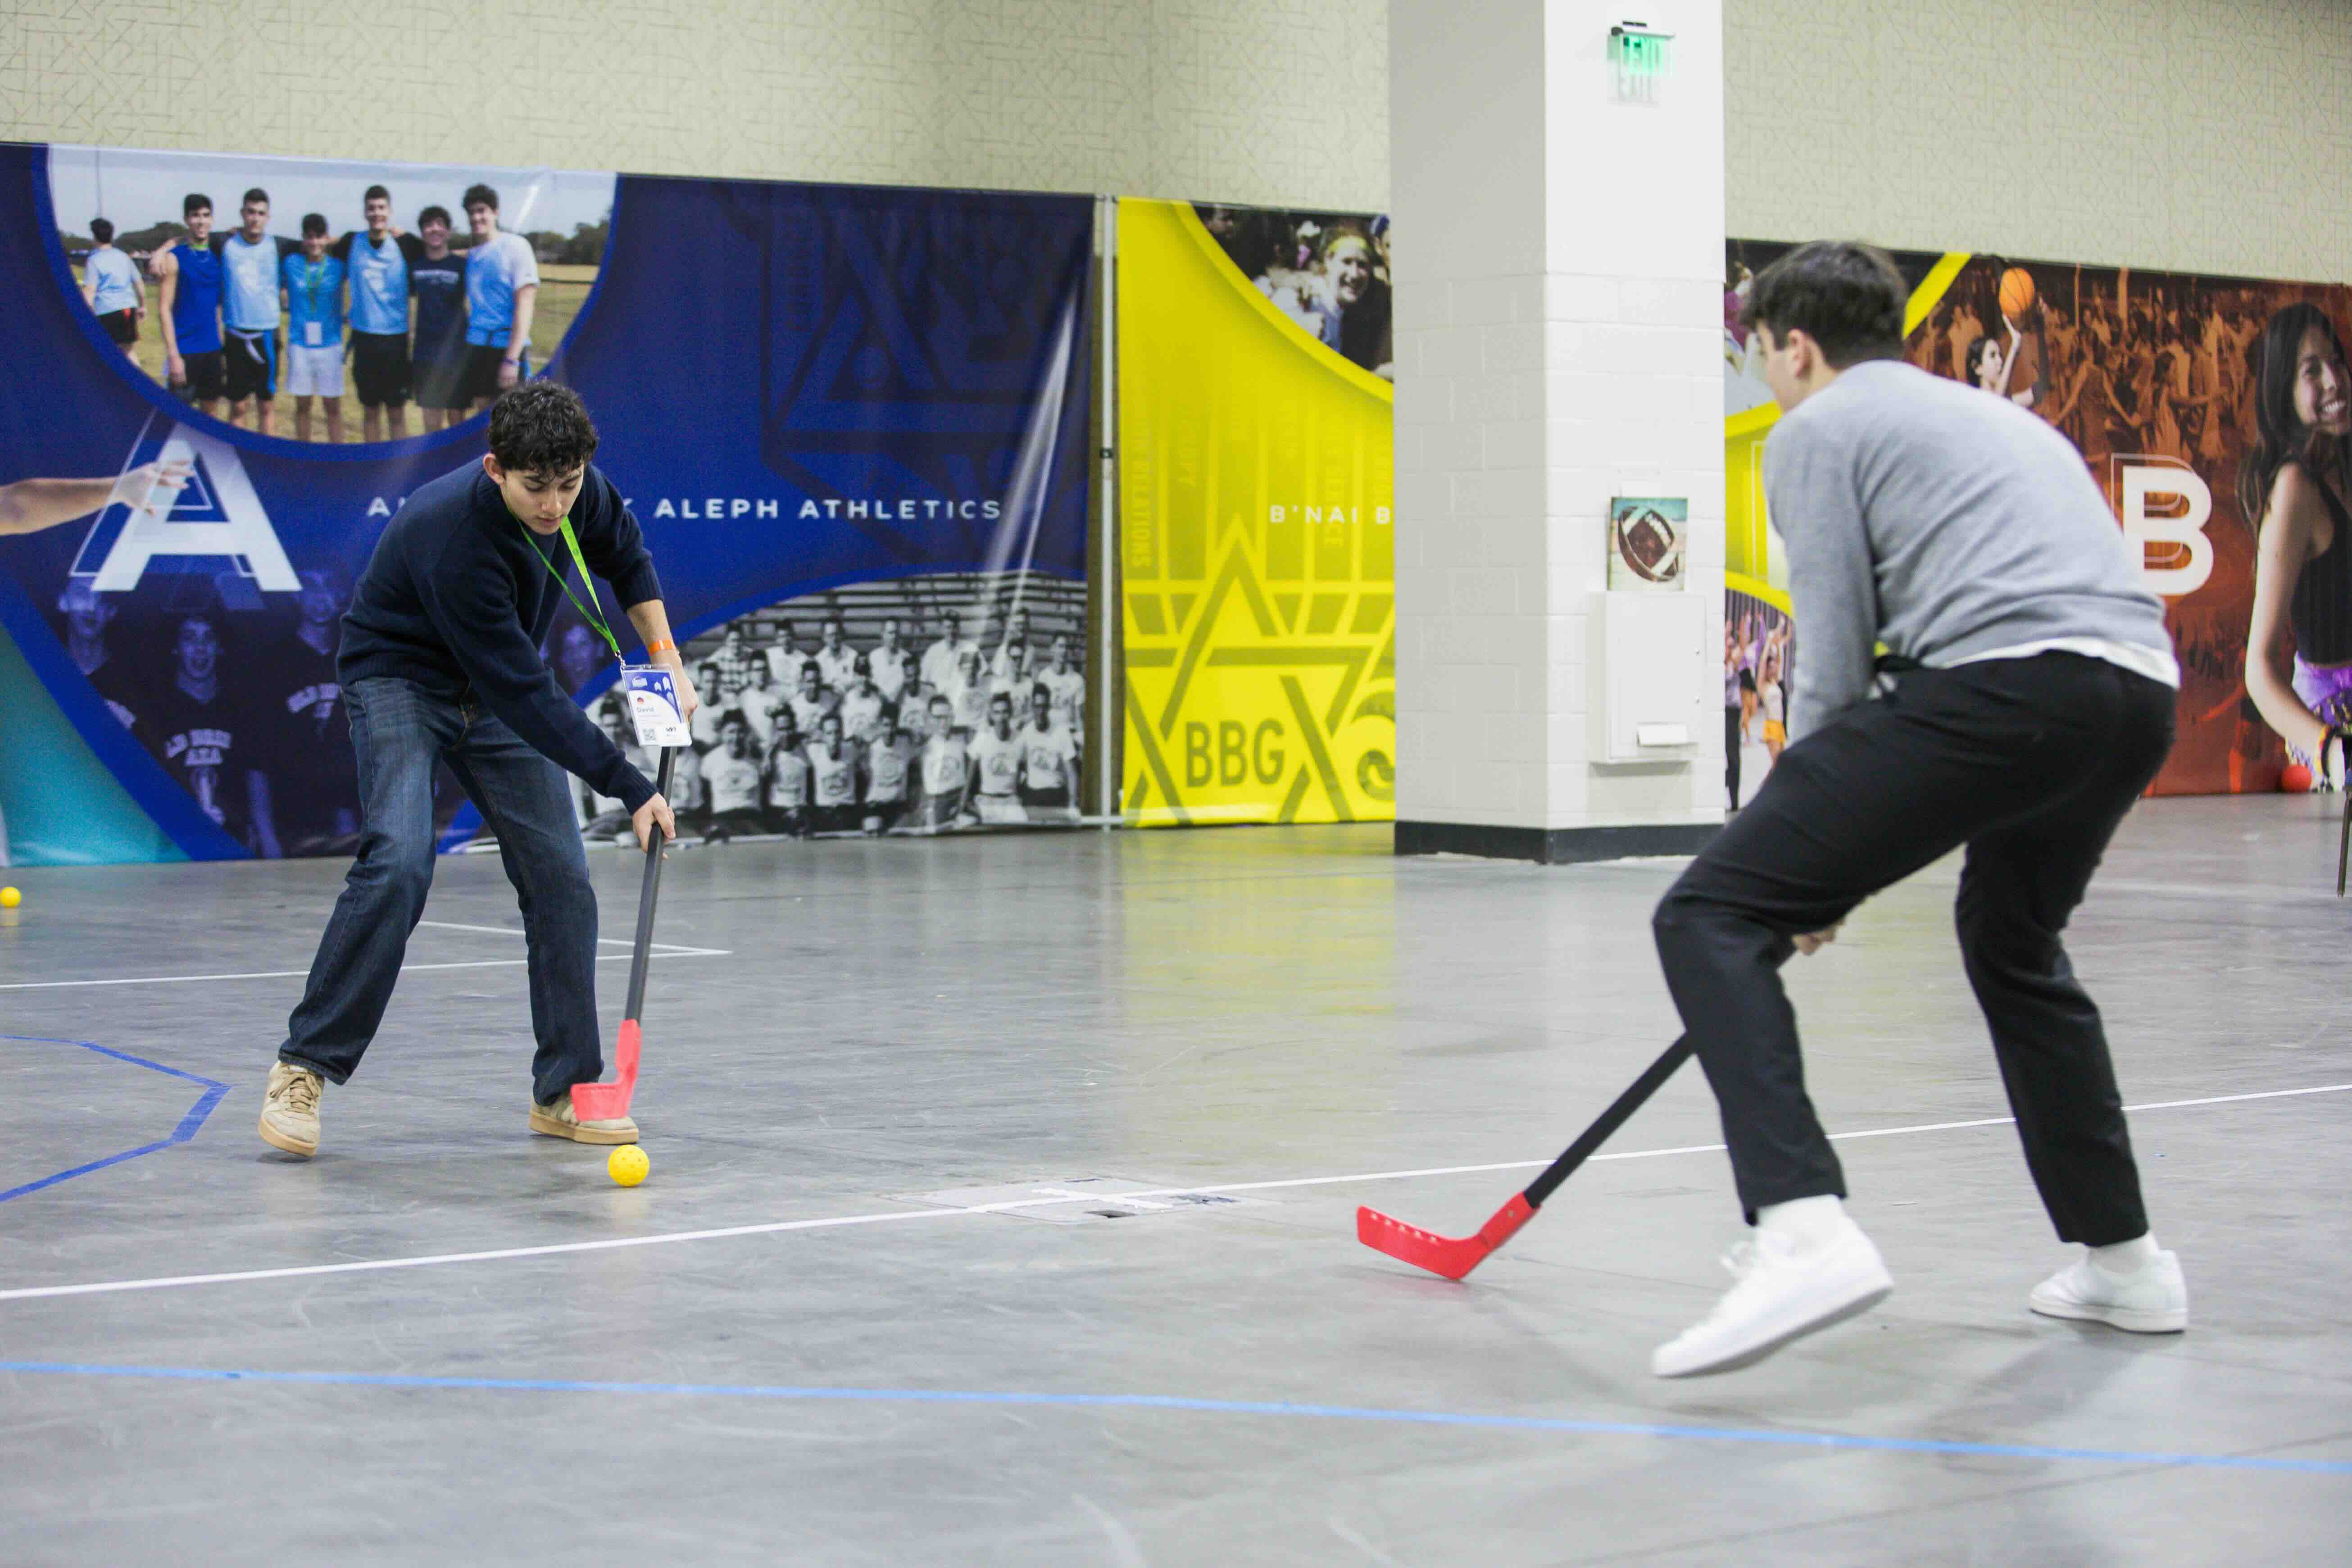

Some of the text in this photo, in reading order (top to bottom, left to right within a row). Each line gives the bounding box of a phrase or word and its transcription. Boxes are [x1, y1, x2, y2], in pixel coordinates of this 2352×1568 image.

[92, 420, 303, 591] A
[654, 498, 779, 519] ALEPH
[798, 499, 1001, 519] ATHLETICS
[1269, 504, 1358, 524] B'NAI
[2122, 466, 2214, 595] B
[1185, 719, 1285, 788] BBG
